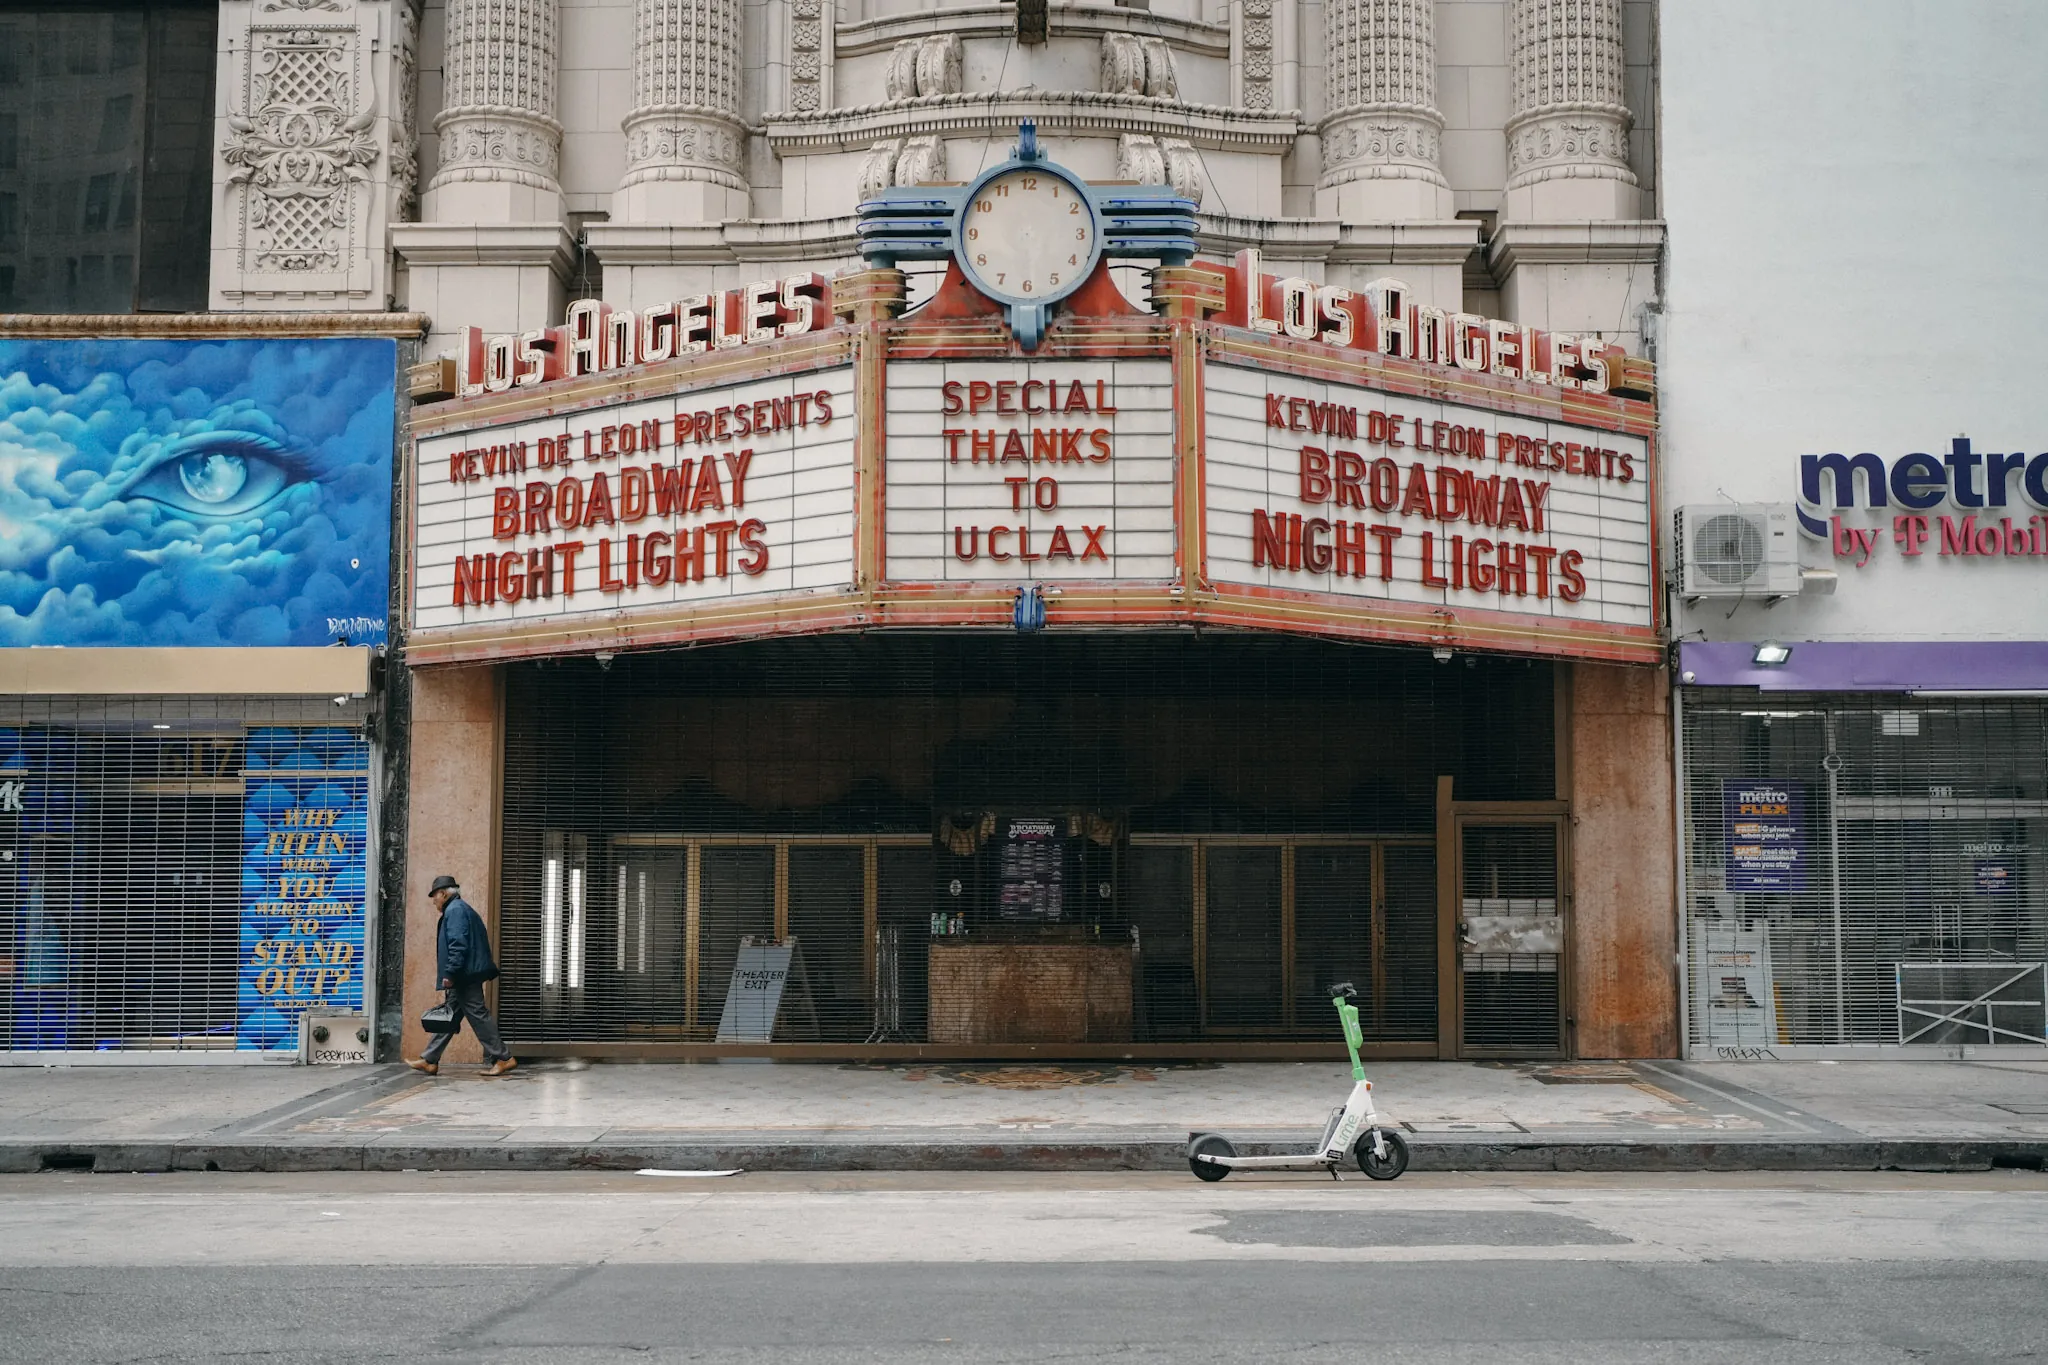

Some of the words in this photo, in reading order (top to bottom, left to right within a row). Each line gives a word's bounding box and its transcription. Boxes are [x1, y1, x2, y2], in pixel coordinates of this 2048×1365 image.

[995, 185, 1010, 197] 11
[1021, 177, 1037, 191] 12
[1052, 186, 1059, 198] 1
[975, 200, 992, 213] 10
[1069, 202, 1079, 215] 2
[968, 227, 979, 241] 9
[1075, 227, 1085, 241] 3
[976, 254, 987, 266] 8
[1068, 254, 1077, 266] 4
[997, 273, 1006, 285] 7
[1023, 279, 1032, 293] 6
[1050, 273, 1059, 286] 5
[1235, 248, 1354, 346] LOS
[455, 326, 552, 397] LOS
[941, 379, 1117, 416] SPECIAL
[450, 441, 526, 483] KEVIN
[537, 433, 572, 469] DE
[584, 418, 660, 462] LEON
[674, 390, 833, 447] PRESENTS
[1266, 393, 1357, 440] KEVIN
[1369, 410, 1404, 448] DE
[1415, 417, 1485, 460] LEON
[1498, 432, 1634, 484] PRESENTS
[942, 428, 1111, 464] THANKS
[493, 448, 753, 540] BROADWAY
[1004, 476, 1058, 512] TO
[1300, 446, 1550, 533] BROADWAY
[954, 525, 1108, 562] UCLAX
[1829, 515, 1883, 567] by
[452, 540, 583, 607] NIGHT
[599, 518, 769, 592] LIGHTS
[1253, 508, 1402, 582] NIGHT
[1422, 531, 1587, 602] LIGHTS
[1740, 790, 1788, 803] metro
[1740, 804, 1789, 814] FLEX
[284, 809, 341, 827] WHY
[1008, 825, 1056, 838] BROADWAY
[264, 832, 314, 854] FIT
[315, 833, 349, 854] IN
[281, 858, 332, 871] WHEN
[277, 877, 337, 898] YOU
[255, 902, 304, 915] WERE
[305, 902, 354, 915] BORN
[290, 918, 319, 935] TO
[251, 940, 354, 965] STAND
[256, 967, 350, 994] OUT?
[735, 970, 785, 979] THEATER
[744, 980, 770, 990] EXIT
[1335, 1114, 1358, 1147] Lime
